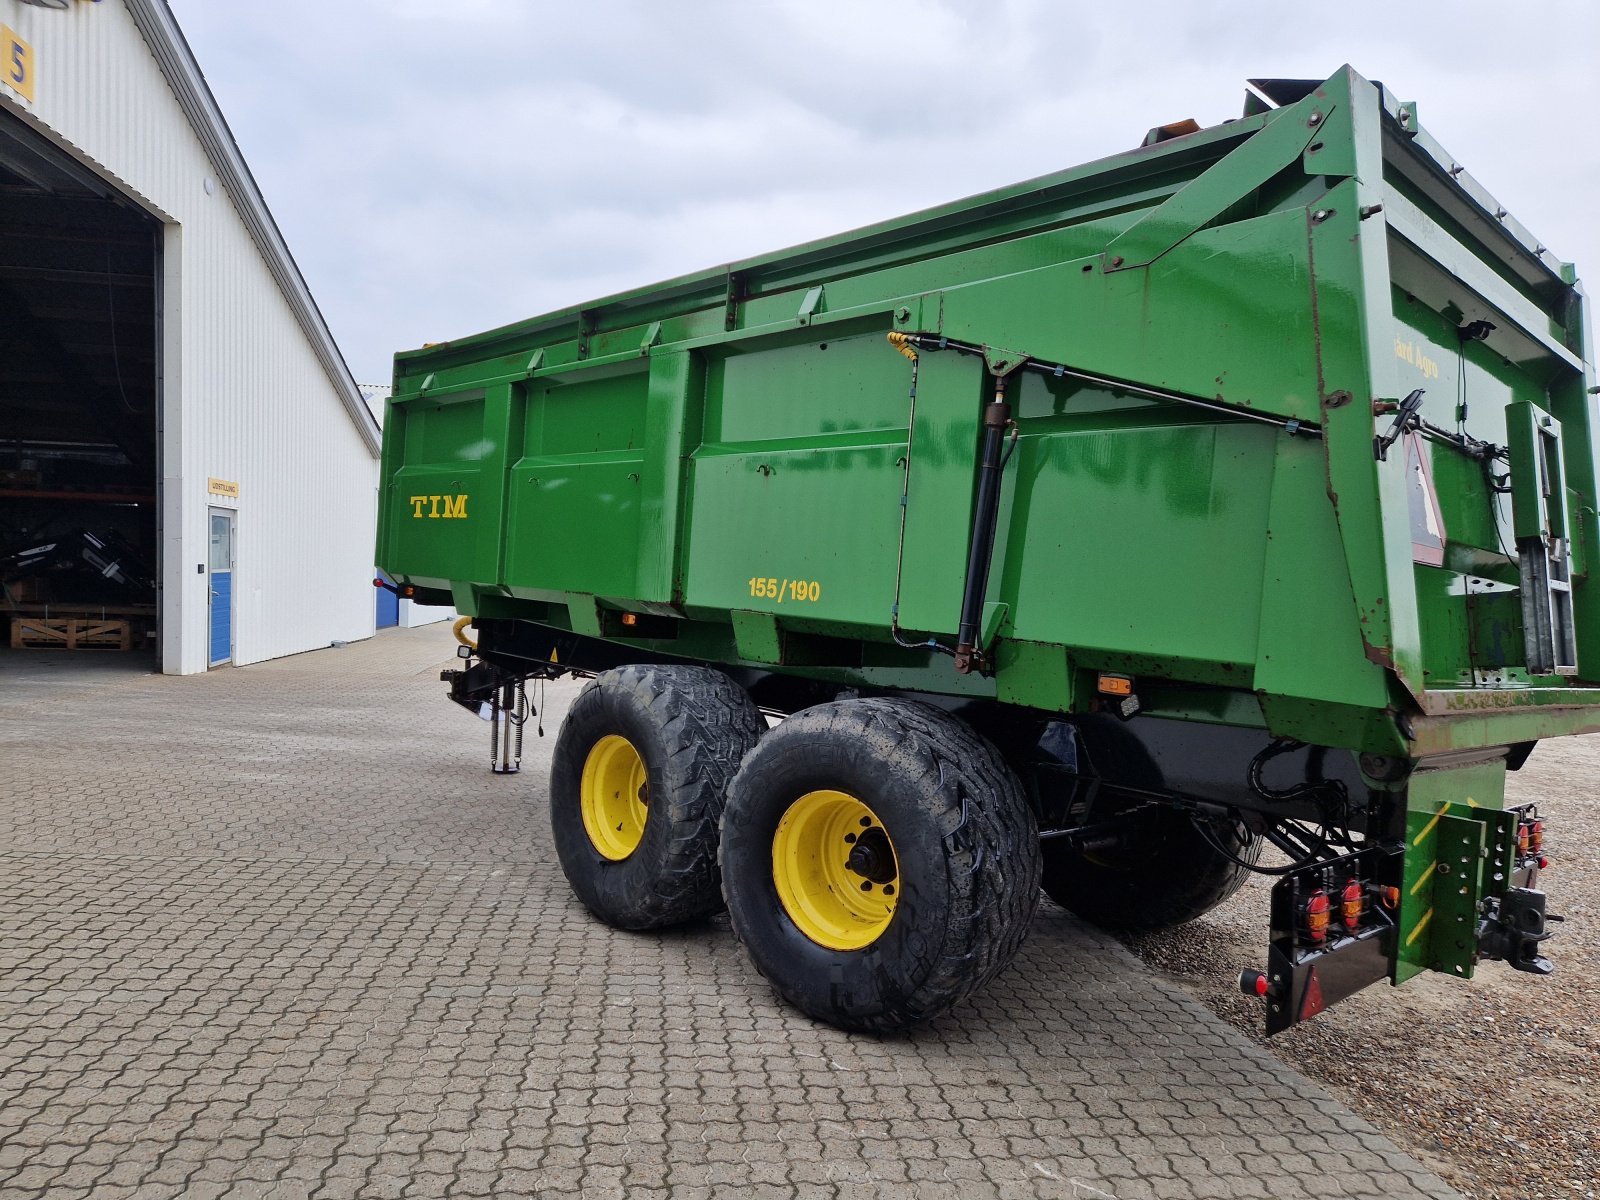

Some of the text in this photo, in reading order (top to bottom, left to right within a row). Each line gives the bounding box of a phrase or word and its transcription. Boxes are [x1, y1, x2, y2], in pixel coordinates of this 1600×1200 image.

[10, 40, 25, 83] 5
[1416, 345, 1438, 379] Agro
[410, 495, 468, 518] TIM
[748, 577, 820, 603] 155/190
